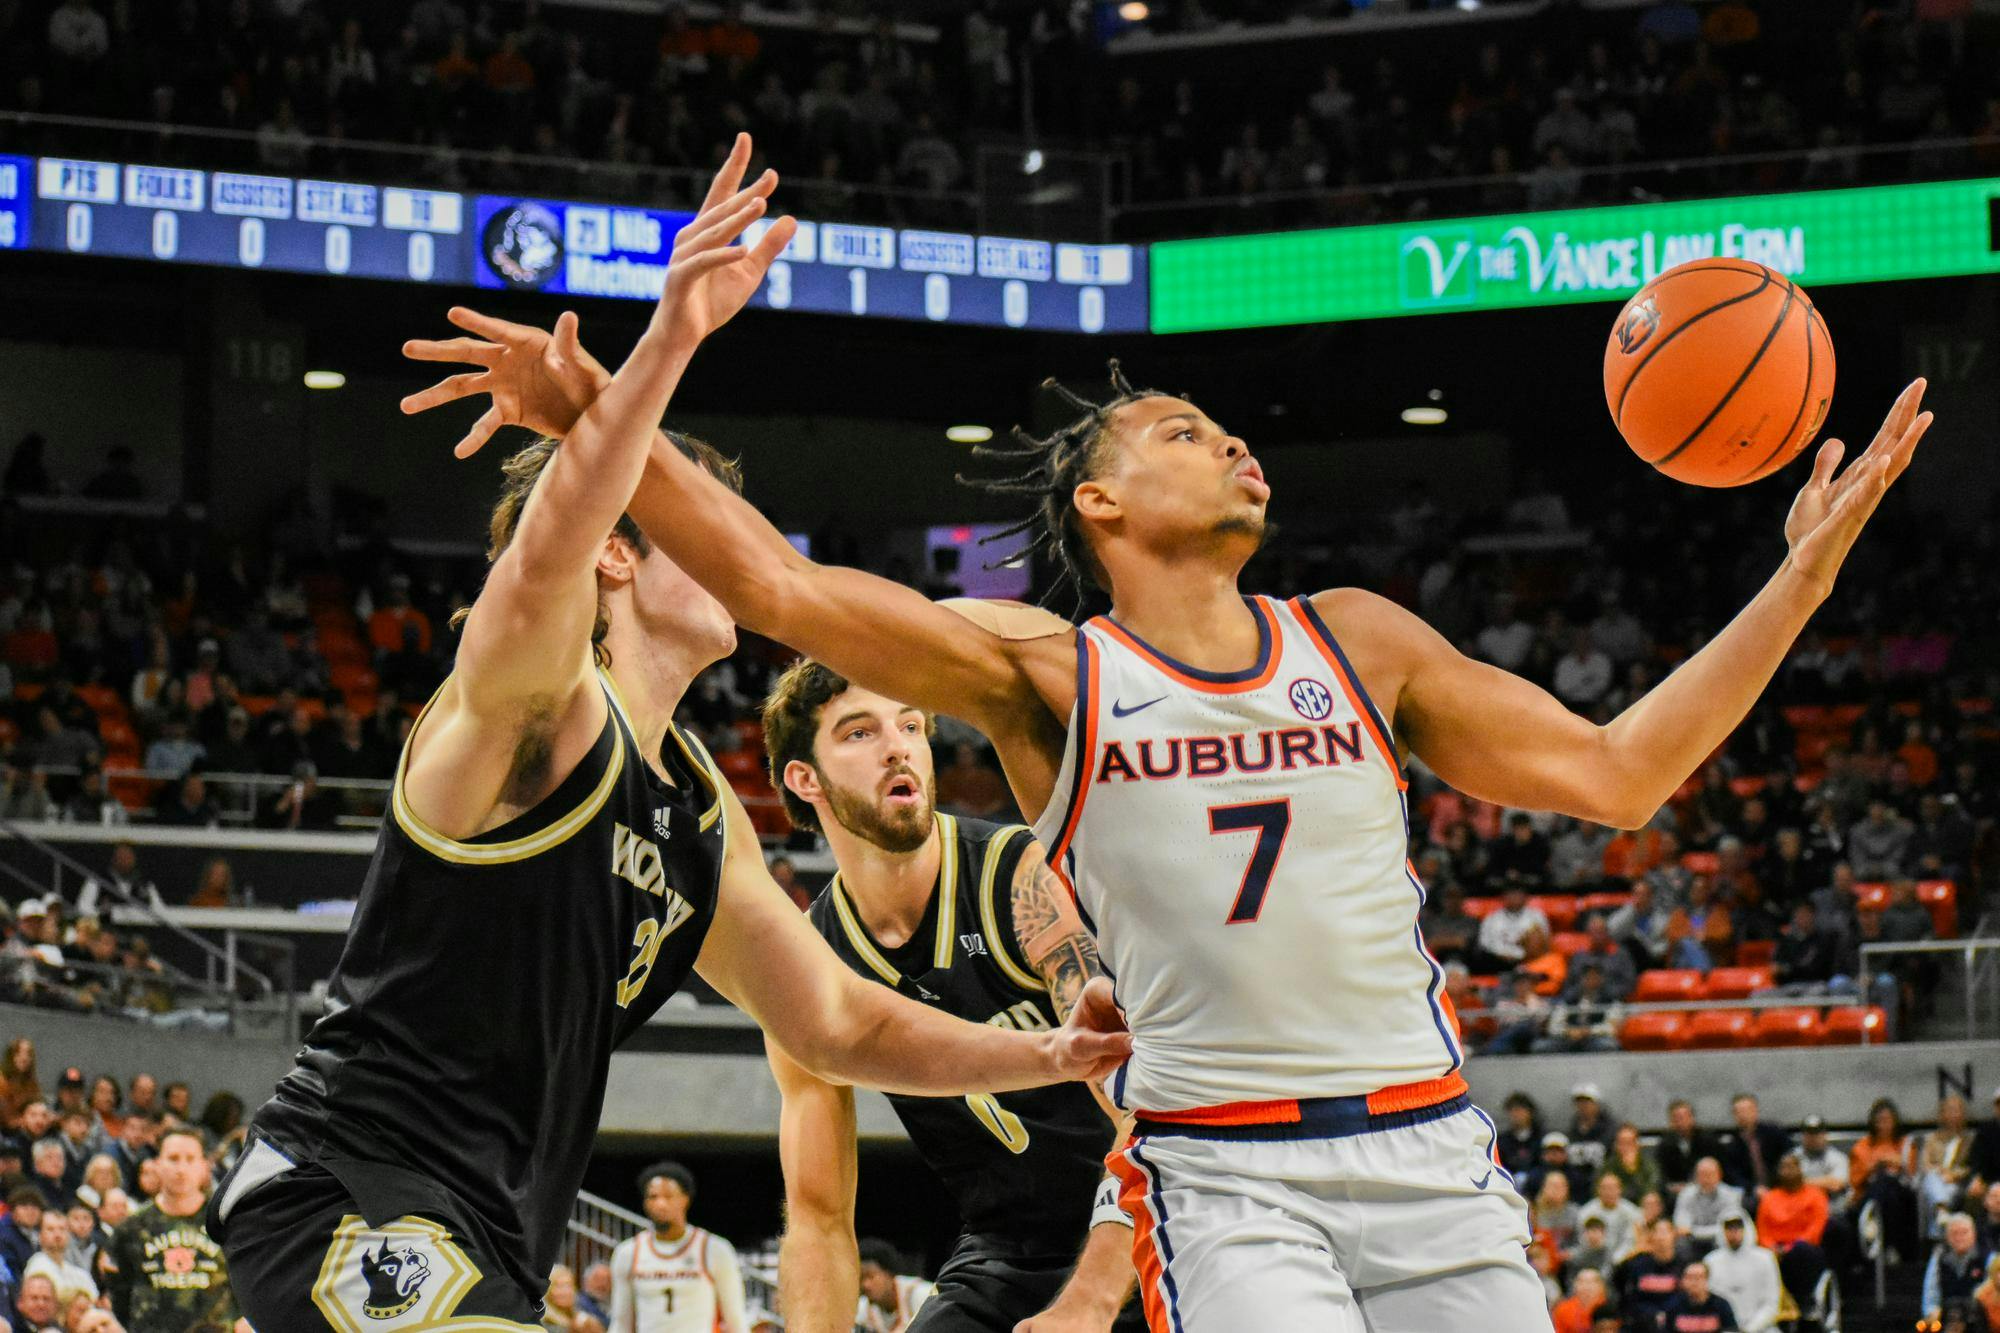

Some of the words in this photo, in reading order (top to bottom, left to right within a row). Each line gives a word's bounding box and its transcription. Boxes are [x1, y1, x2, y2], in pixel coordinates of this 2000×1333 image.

[66, 203, 93, 252] 0
[152, 210, 178, 260] 0
[238, 218, 265, 268] 0
[324, 225, 350, 275] 0
[407, 232, 433, 282] 0
[1479, 245, 1515, 280] THE
[1500, 226, 1638, 292] VANCE
[766, 261, 791, 310] 3
[849, 267, 866, 316] 1
[924, 273, 950, 322] 0
[1003, 280, 1028, 329] 0
[1079, 286, 1106, 334] 0
[1290, 680, 1331, 719] SEC
[1096, 721, 1365, 784] AUBURN
[1207, 797, 1292, 926] 7
[150, 1271, 210, 1289] TIGERS
[662, 1287, 674, 1314] 1
